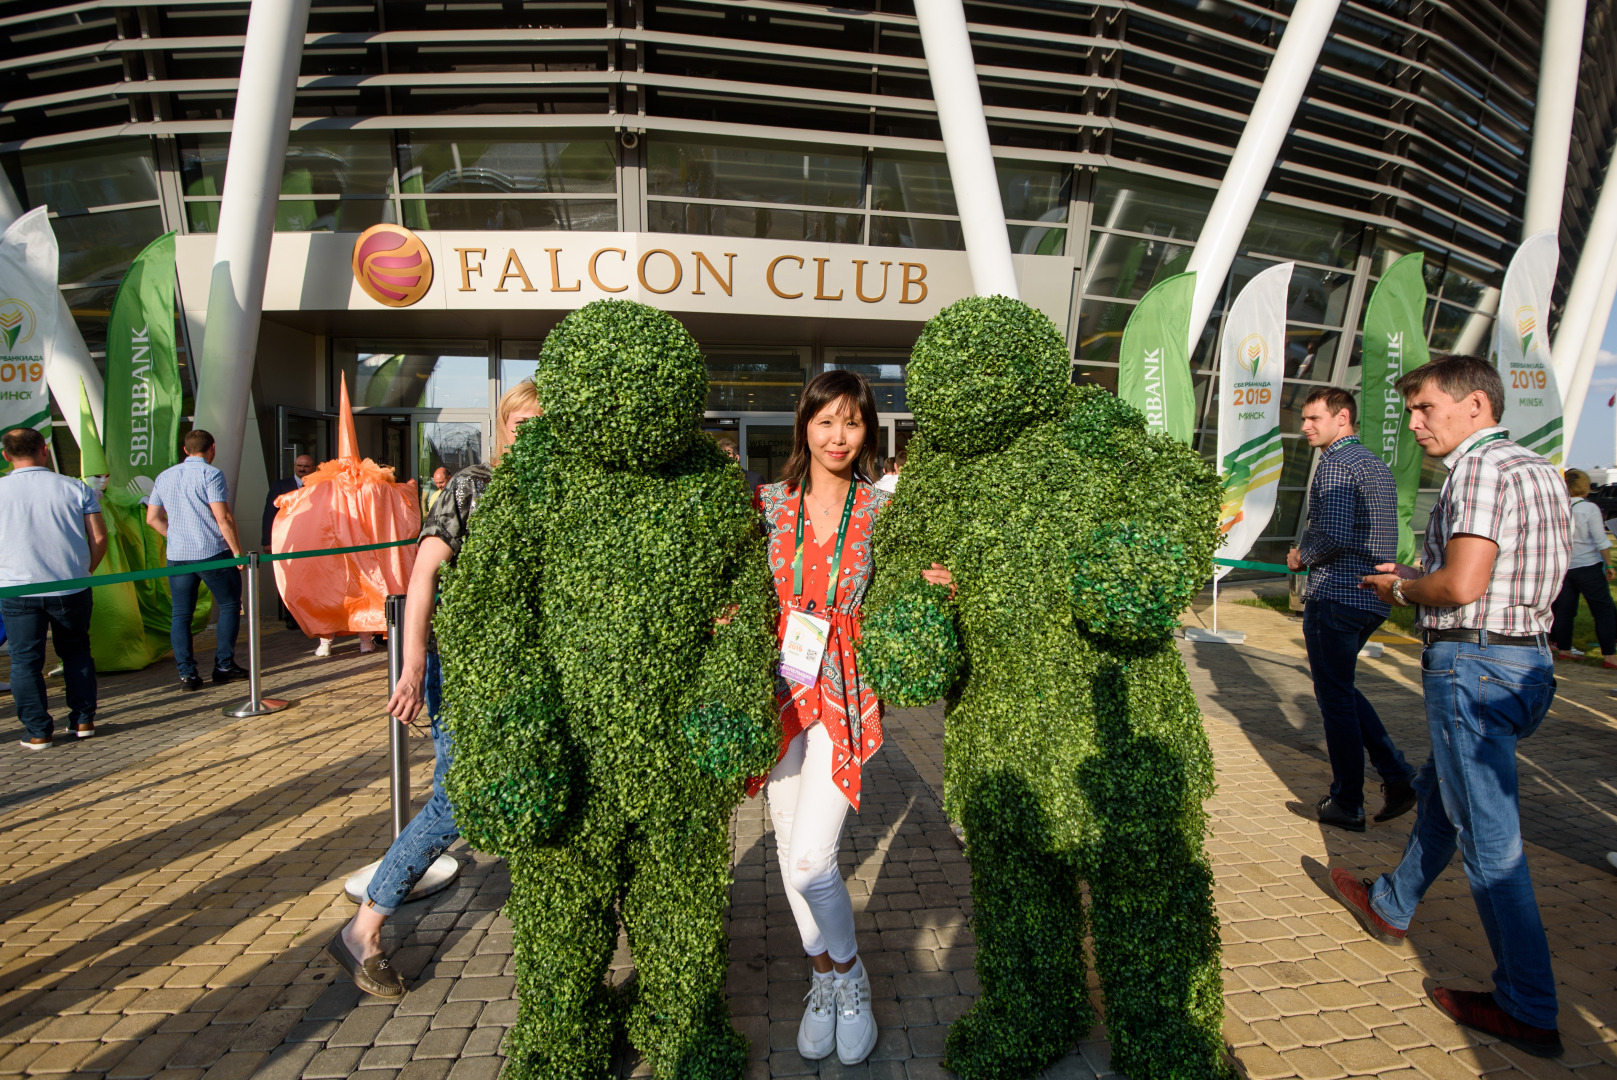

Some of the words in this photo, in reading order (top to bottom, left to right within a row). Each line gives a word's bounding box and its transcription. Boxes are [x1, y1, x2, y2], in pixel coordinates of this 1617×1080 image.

[453, 246, 738, 297] FALCON
[766, 254, 929, 305] CLUB
[1510, 369, 1547, 389] 2019
[130, 322, 151, 467] SBERBANK
[1233, 388, 1272, 406] 2019
[1381, 331, 1401, 468] СБЕРБАНК
[1519, 397, 1544, 407] MINSK
[1238, 411, 1265, 421] МИНСК
[749, 439, 794, 447] WELCOME
[788, 642, 803, 652] 2019
